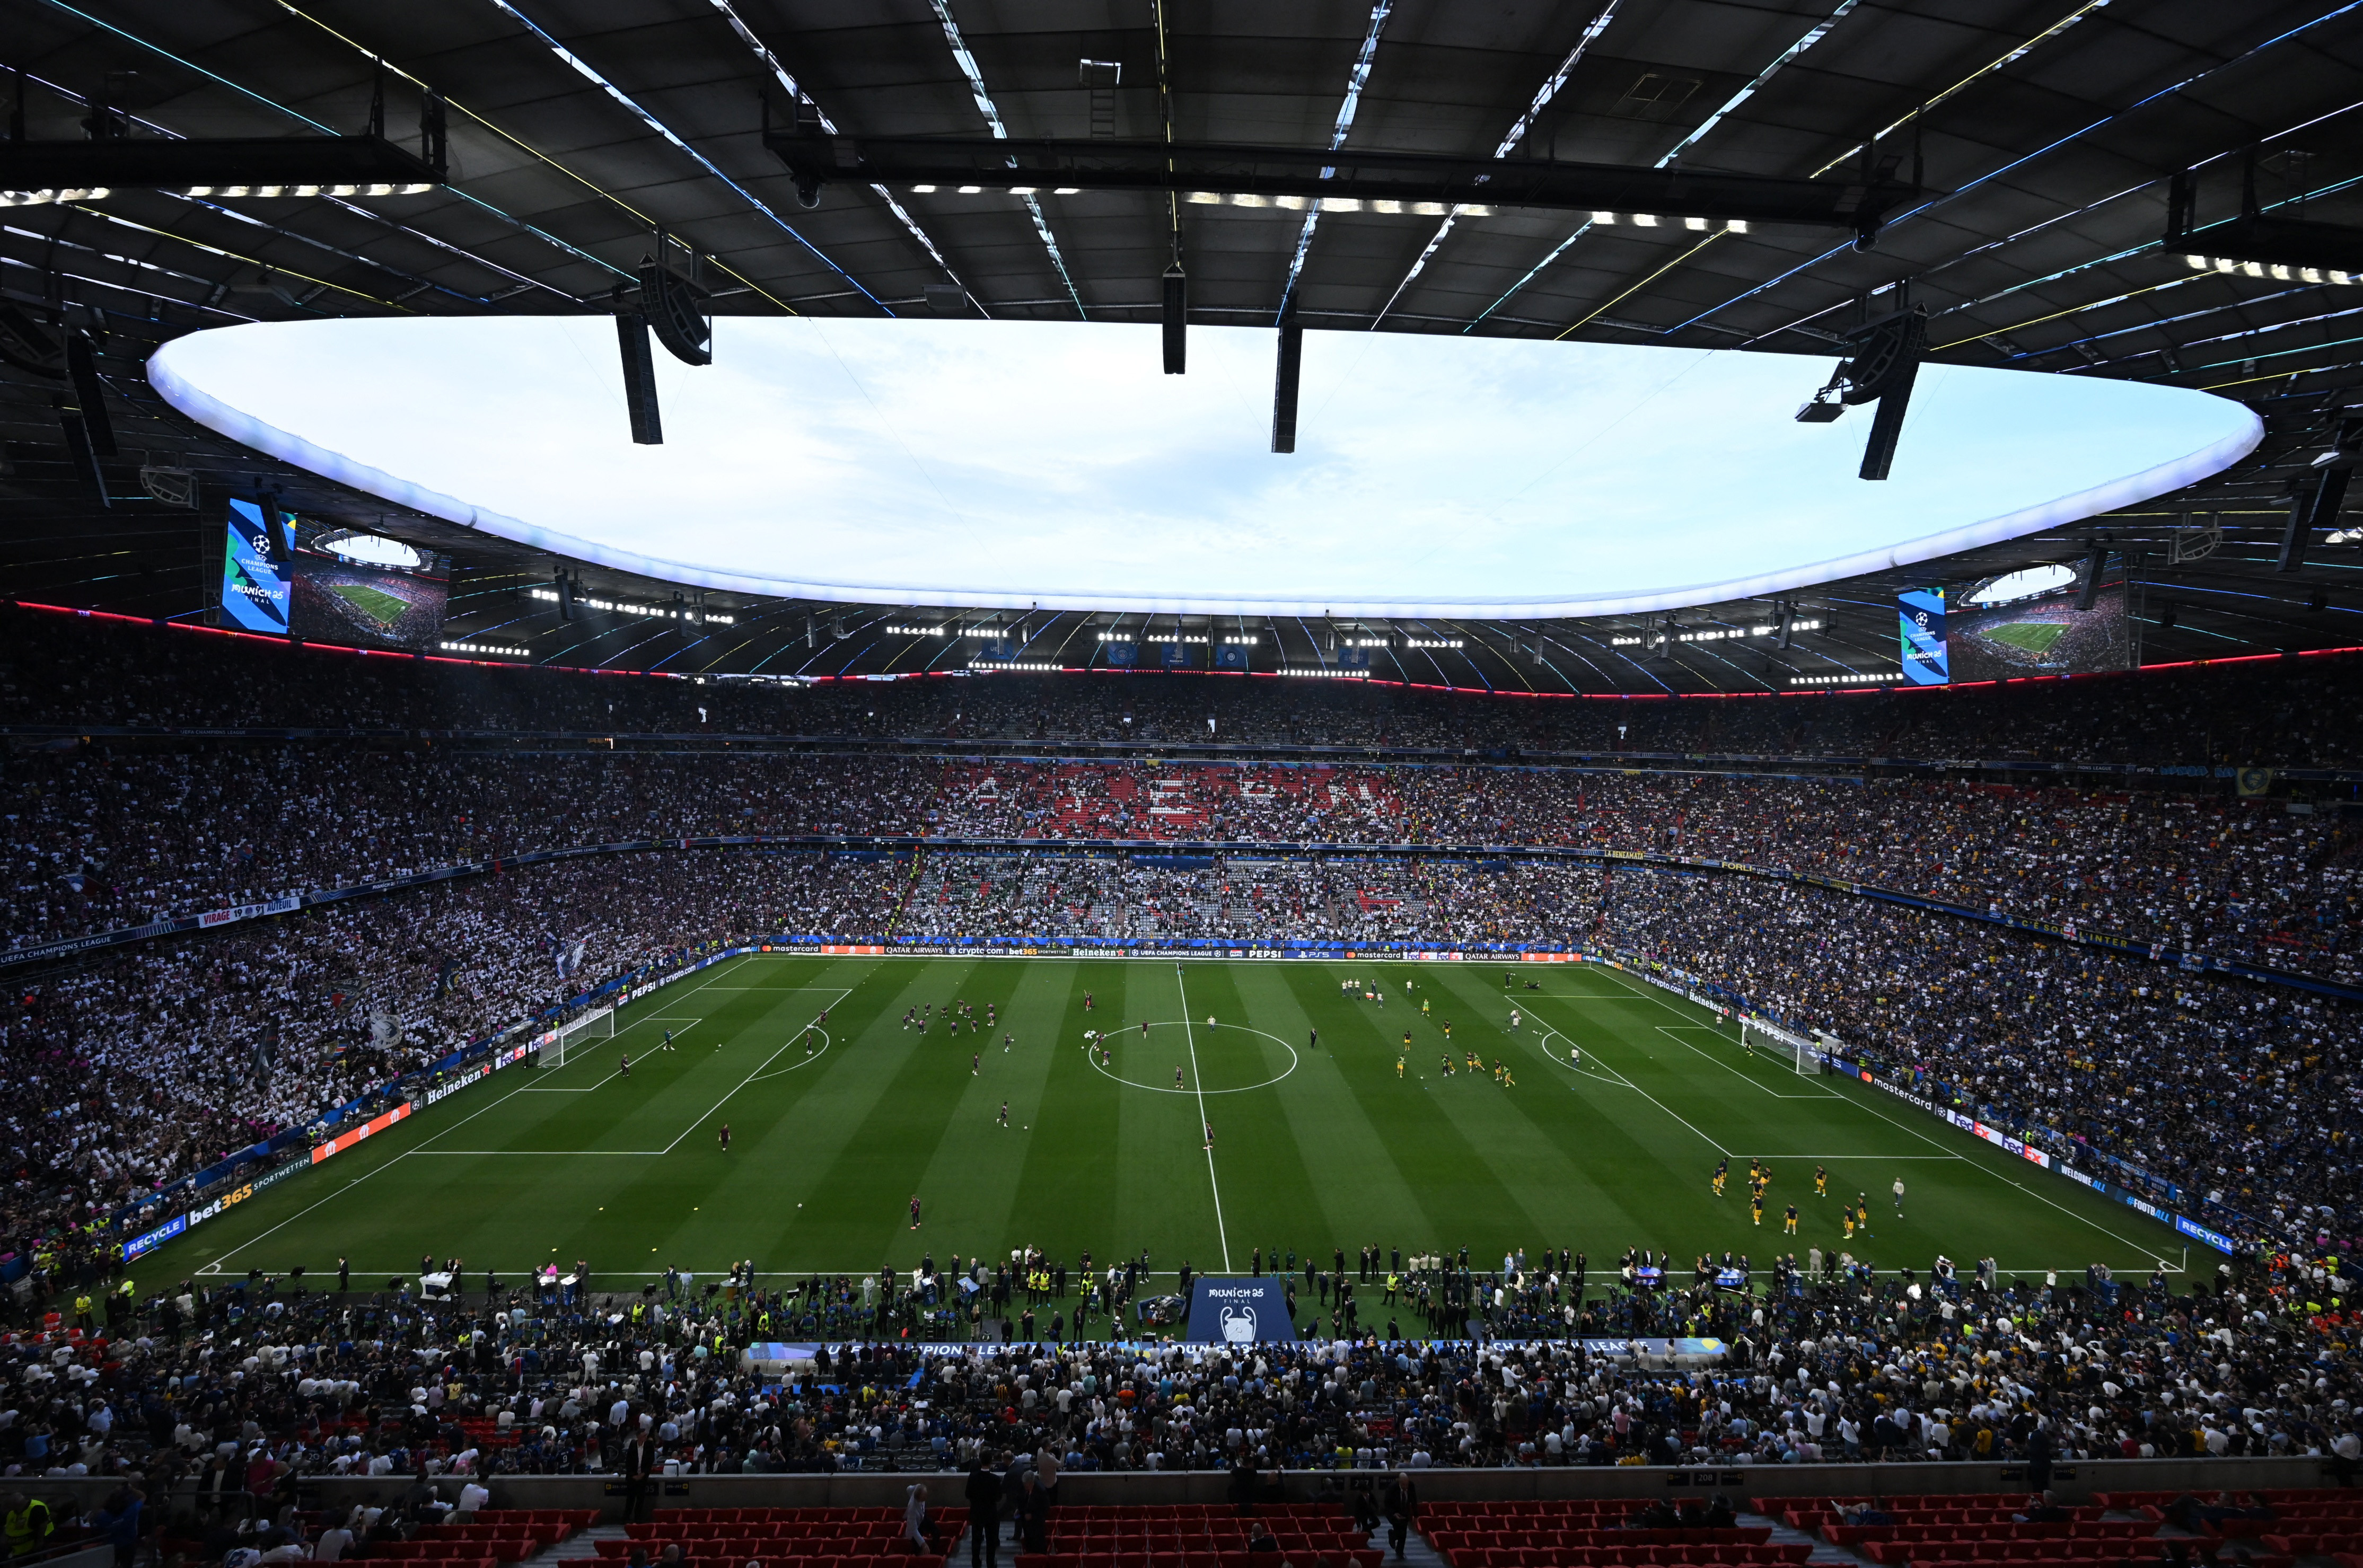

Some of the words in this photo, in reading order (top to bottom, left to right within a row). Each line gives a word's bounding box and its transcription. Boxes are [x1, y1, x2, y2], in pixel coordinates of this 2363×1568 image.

[241, 558, 278, 570] CHAMPIONS
[248, 566, 272, 575] LEAGUE
[231, 584, 271, 597] MUNICH
[273, 591, 284, 600] 25
[245, 596, 269, 604] FINAL
[1907, 651, 1933, 661] MUNICH
[1612, 851, 1644, 860] BENEAMATA
[372, 882, 391, 890] MUNICH
[234, 909, 243, 918] 19
[256, 904, 264, 915] 91
[267, 899, 292, 912] AUTEUIL
[204, 910, 230, 925] VIRAGE
[2079, 930, 2128, 948] L'INTER
[1, 954, 25, 964] UEFA
[27, 942, 78, 958] CHAMPIONS
[81, 936, 112, 947] LEAGUE
[713, 952, 725, 963] PS5
[666, 965, 696, 983] crypto.com
[1604, 958, 1623, 971] bet365
[1623, 966, 1642, 978] SPORTWETTEN
[631, 981, 656, 1000] PEPSI
[1650, 976, 1684, 996] crypto.com
[1689, 991, 1723, 1013] Heineken
[567, 1016, 587, 1032] QATAR
[588, 1002, 612, 1020] AIRWAYS
[1754, 1020, 1784, 1043] PEPSI
[532, 1033, 555, 1052] FedEx
[500, 1047, 526, 1067] FedEx
[1819, 1053, 1842, 1069] PS5
[427, 1069, 481, 1105] Heineken
[1874, 1077, 1932, 1111] mastercard
[1954, 1113, 1990, 1140] FedEx
[2002, 1134, 2042, 1166] FedEx
[2061, 1165, 2092, 1186] WELCOME
[2092, 1179, 2106, 1193] ALL
[190, 1183, 252, 1226] bet365
[254, 1157, 310, 1191] SPORTWETTEN
[2126, 1195, 2169, 1223] #FOOTBALL
[128, 1221, 180, 1254] RECYCLE
[2182, 1220, 2233, 1251] RECYCLE
[1209, 1287, 1251, 1298] MUNICH
[1252, 1288, 1263, 1297] 25
[1413, 1434, 1421, 1443] 10
